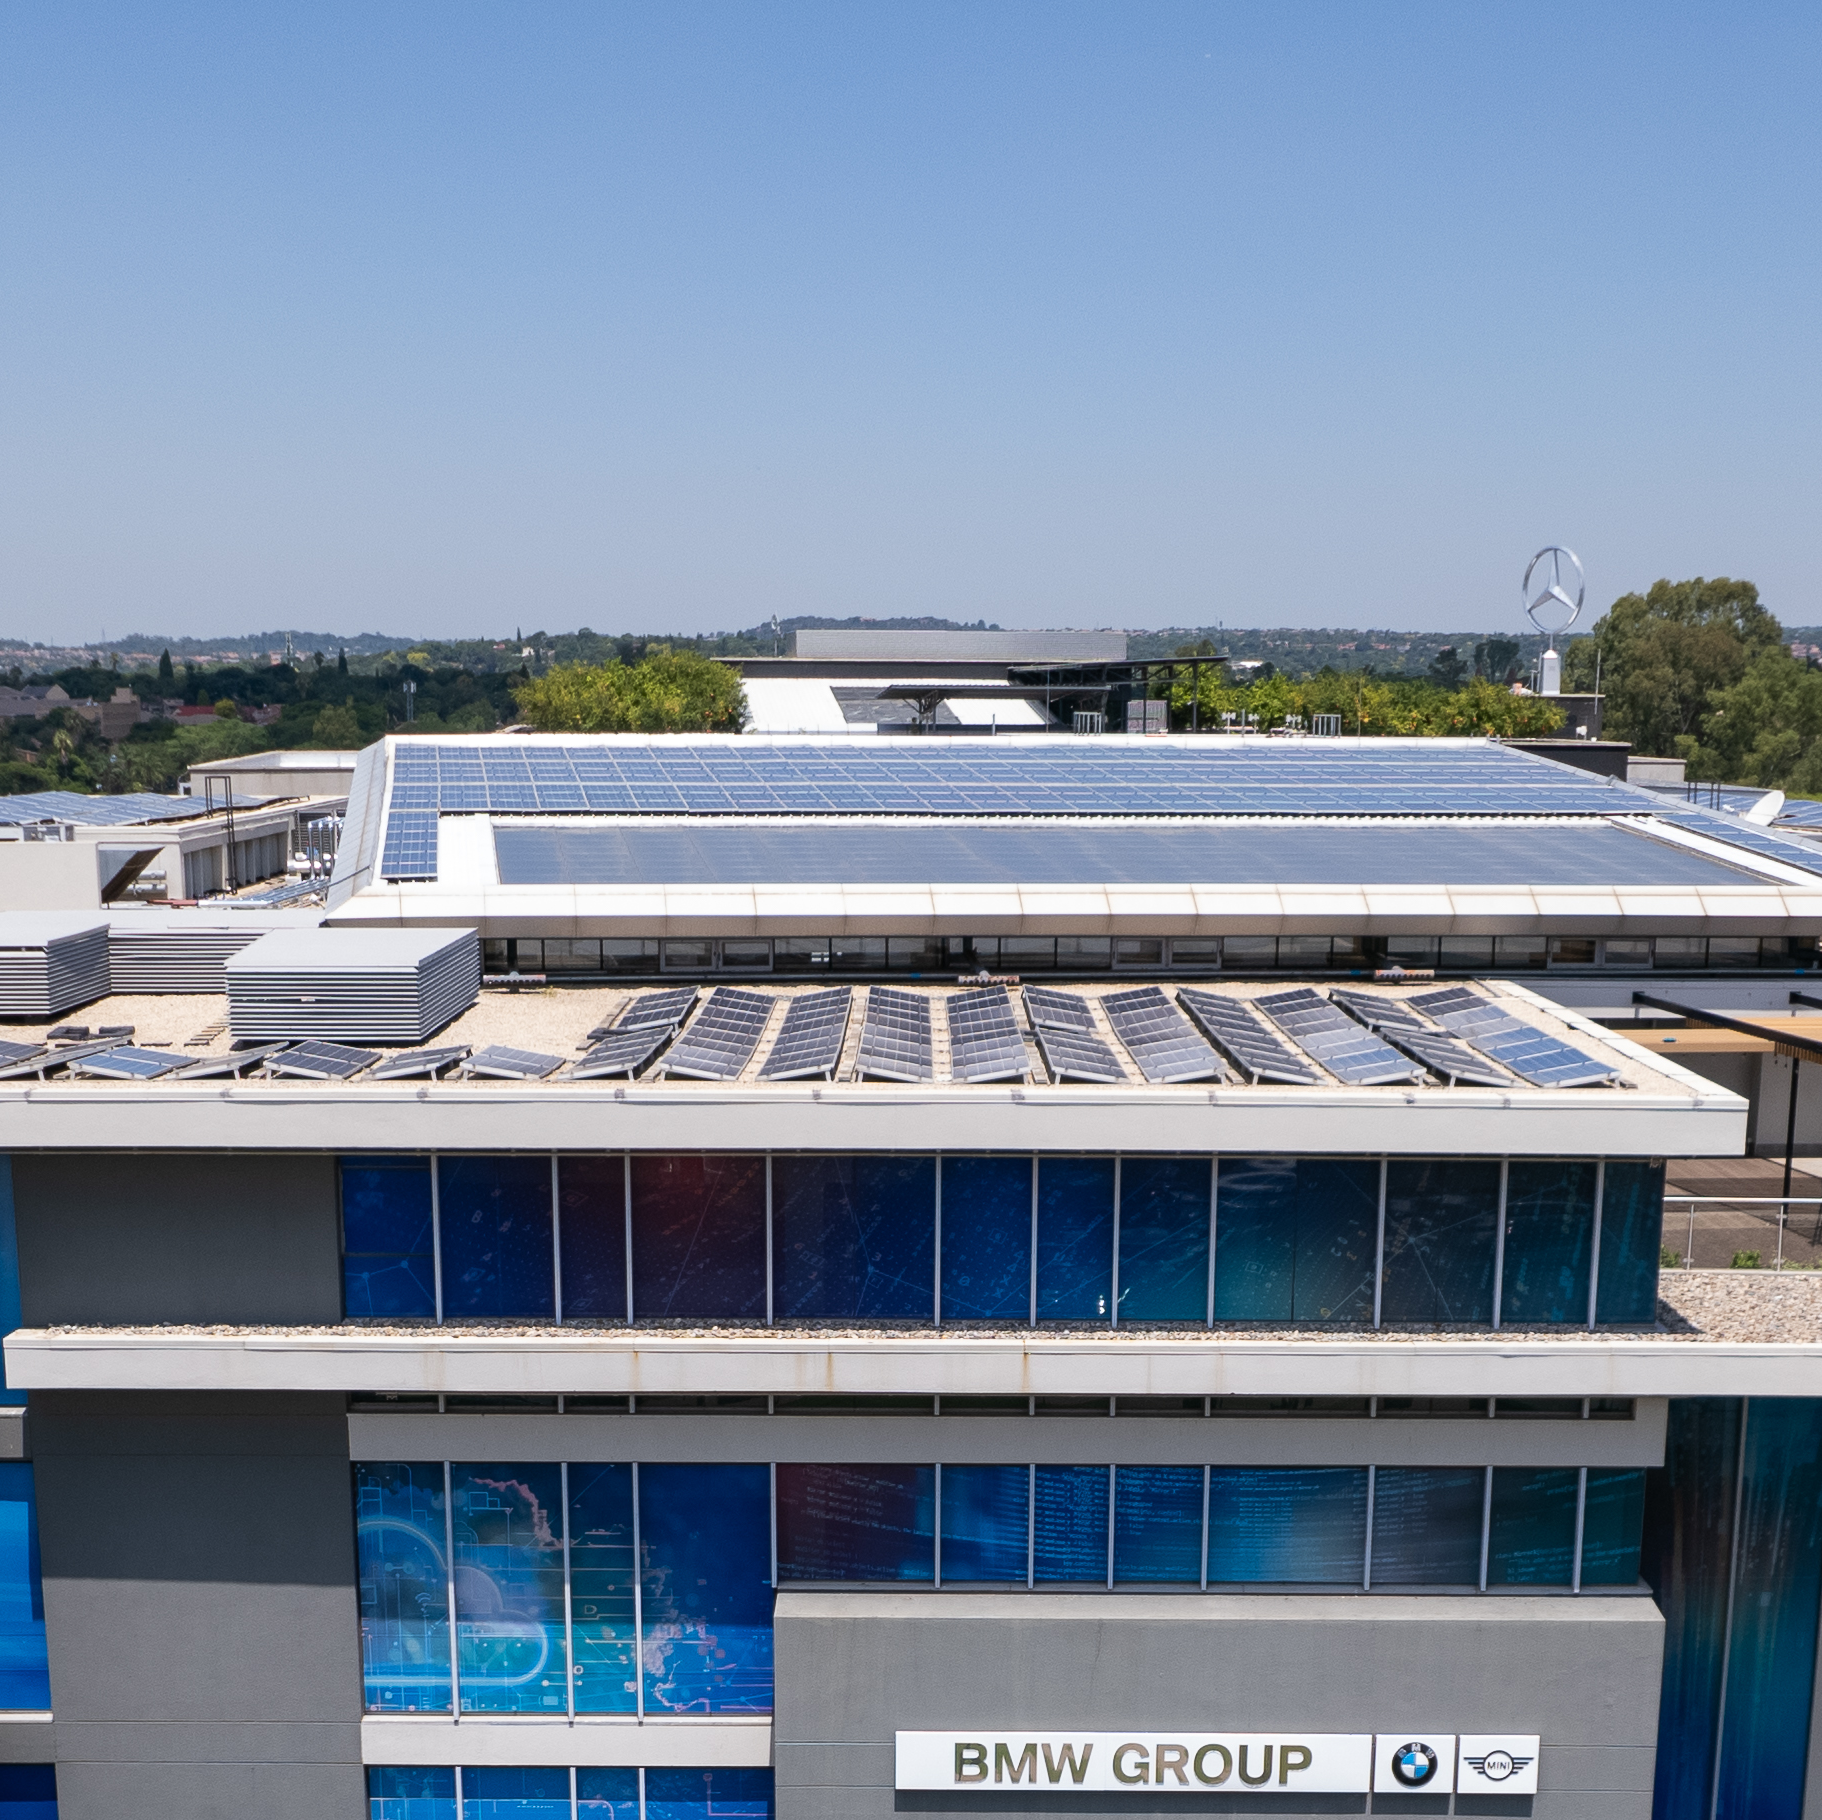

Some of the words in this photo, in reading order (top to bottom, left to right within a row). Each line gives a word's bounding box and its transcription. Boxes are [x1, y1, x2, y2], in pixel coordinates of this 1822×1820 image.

[954, 1742, 1094, 1784] BMW
[1113, 1743, 1313, 1788] GROUP
[1487, 1761, 1511, 1770] MINI
